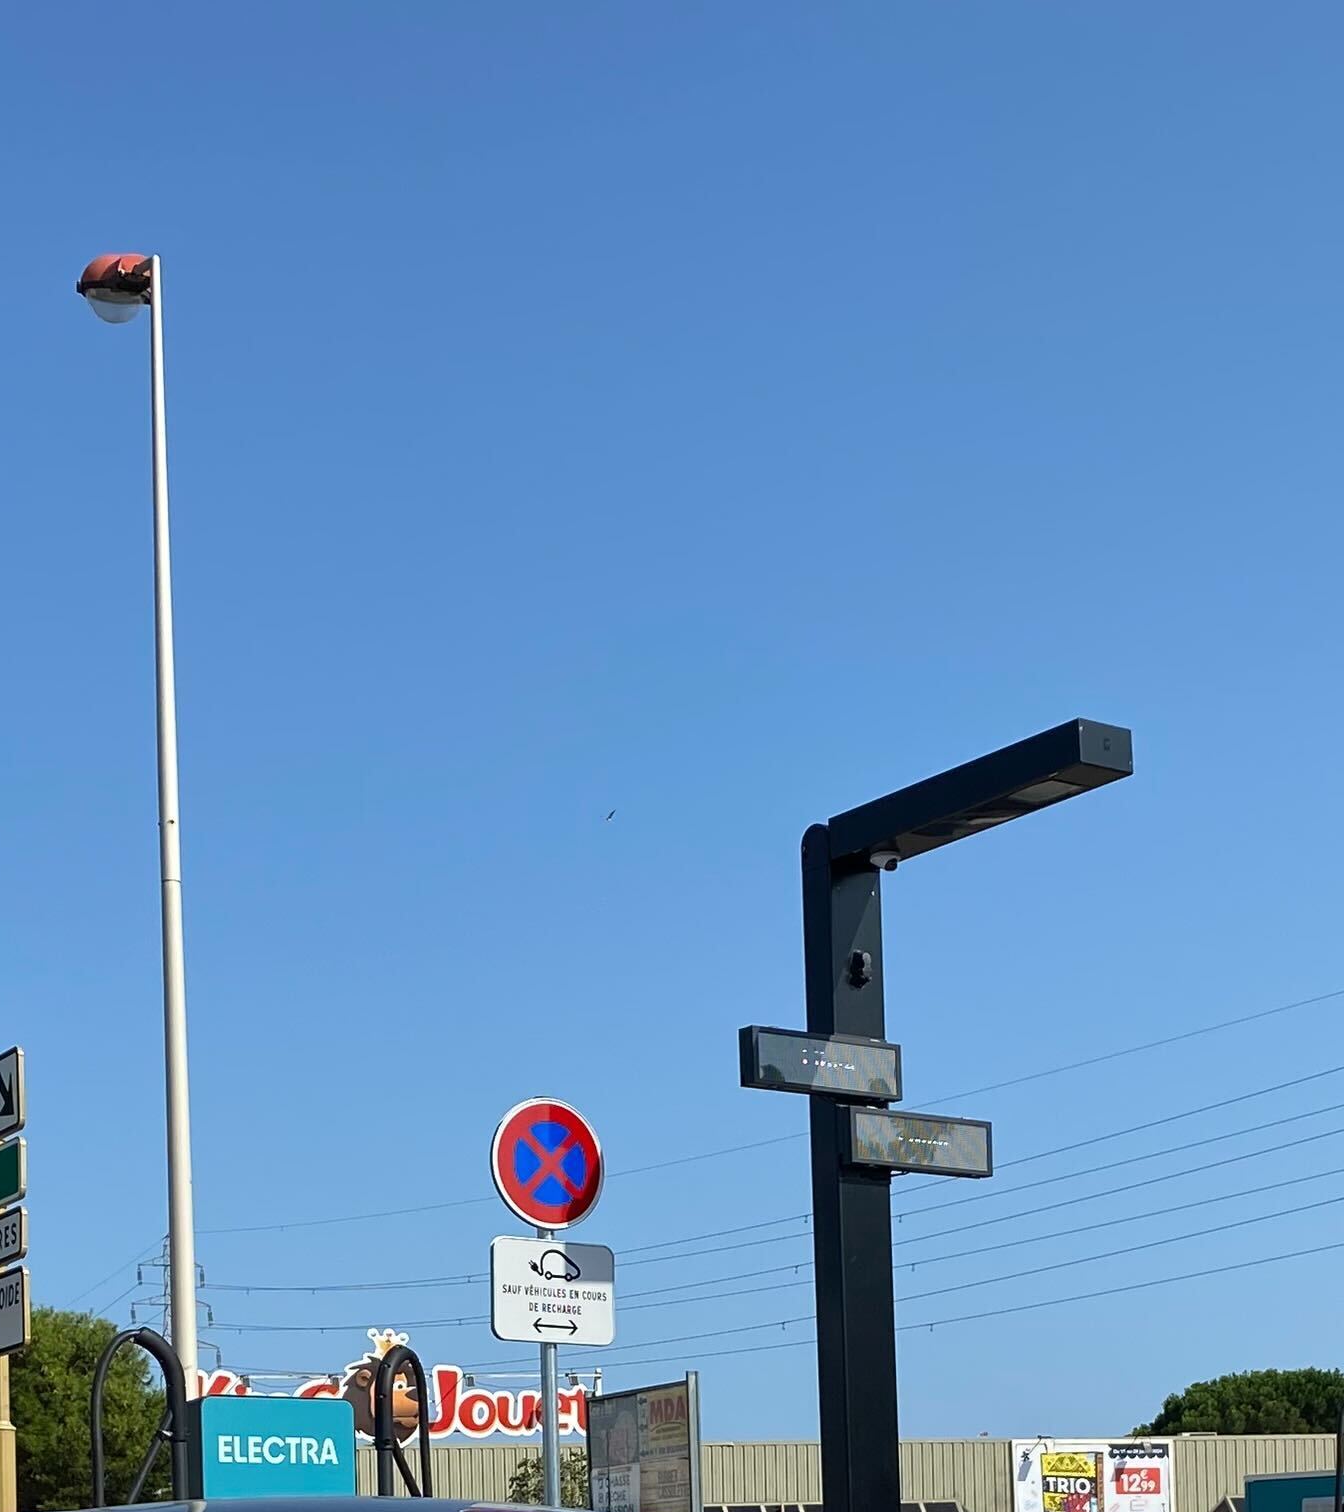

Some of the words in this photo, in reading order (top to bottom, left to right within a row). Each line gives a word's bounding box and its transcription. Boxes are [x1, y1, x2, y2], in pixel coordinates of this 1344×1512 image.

[502, 1283, 522, 1295] SAUF
[524, 1284, 567, 1299] VÉHICULES
[569, 1289, 579, 1299] EN
[582, 1290, 607, 1301] COURS
[529, 1302, 538, 1312] DE
[541, 1302, 582, 1316] RECHARGE
[649, 1396, 686, 1425] MDA
[218, 1435, 339, 1464] ELECTRA
[1045, 1478, 1091, 1494] TRIO
